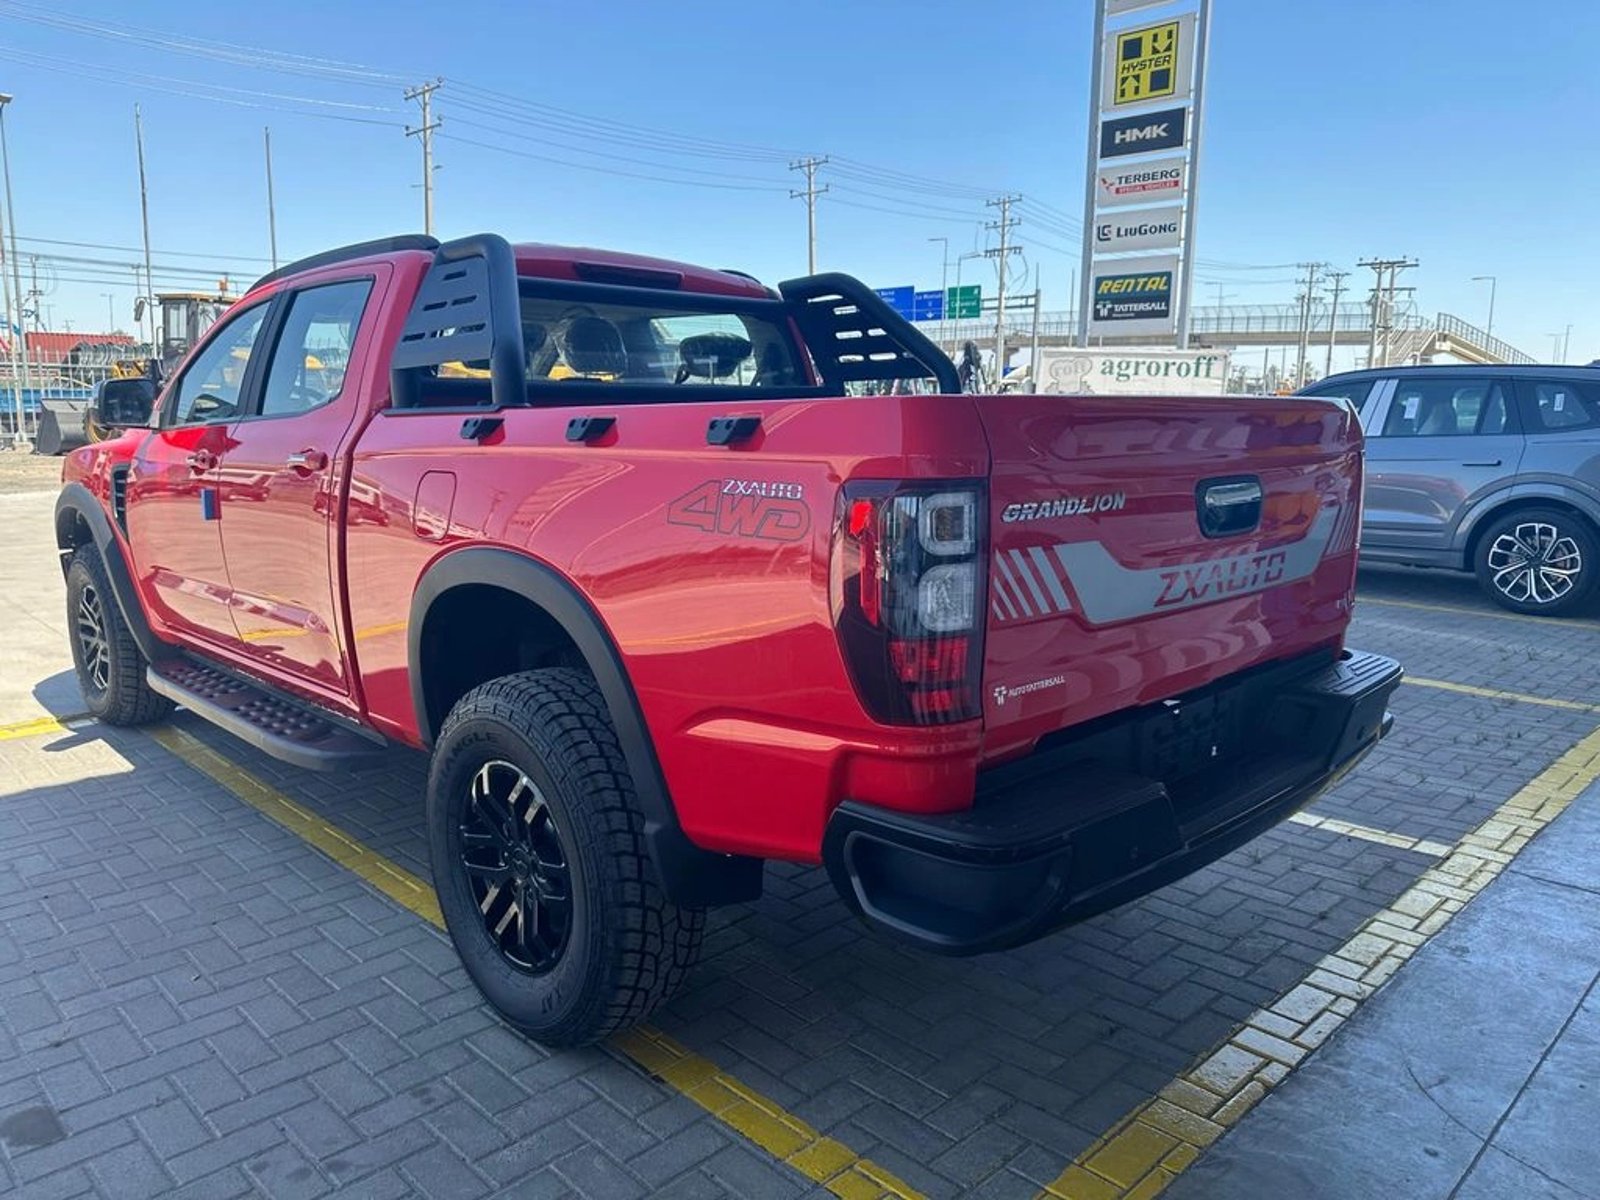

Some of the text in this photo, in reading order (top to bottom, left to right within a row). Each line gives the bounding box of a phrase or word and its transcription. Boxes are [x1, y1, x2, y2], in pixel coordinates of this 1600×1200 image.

[1121, 54, 1172, 75] HYSTER
[1114, 122, 1170, 145] HMK
[1117, 168, 1181, 186] TERBERG
[1097, 275, 1170, 295] RENTAL
[1113, 301, 1168, 312] TATTERSALL
[1100, 355, 1219, 382] agroroff
[722, 478, 804, 500] ZXAUTO
[666, 479, 812, 543] 4WD
[1001, 489, 1126, 523] GRANDLION
[1153, 551, 1287, 608] ZXAUTO
